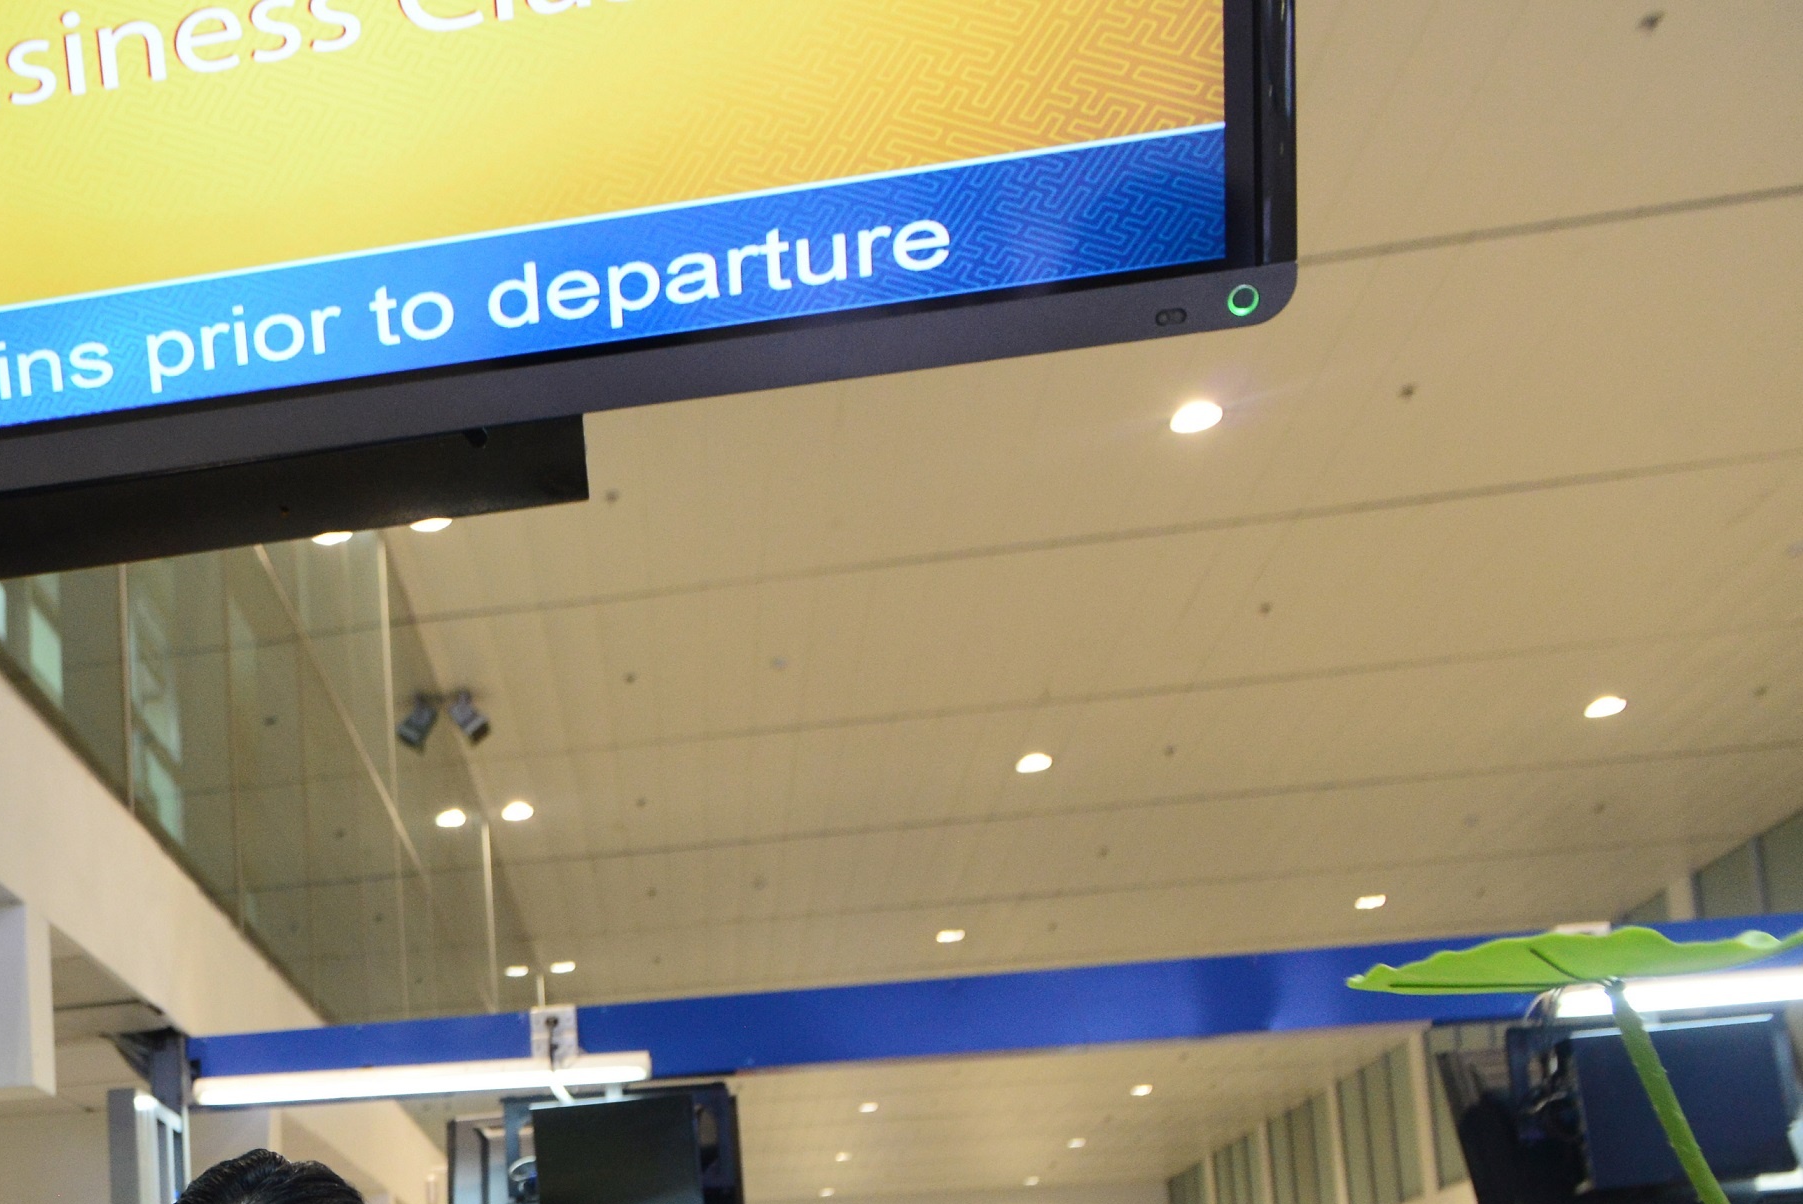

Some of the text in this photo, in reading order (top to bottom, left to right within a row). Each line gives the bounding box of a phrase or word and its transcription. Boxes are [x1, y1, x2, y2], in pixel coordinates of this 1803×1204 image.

[146, 304, 343, 394] prior
[369, 286, 455, 347] to
[487, 217, 952, 328] departure
